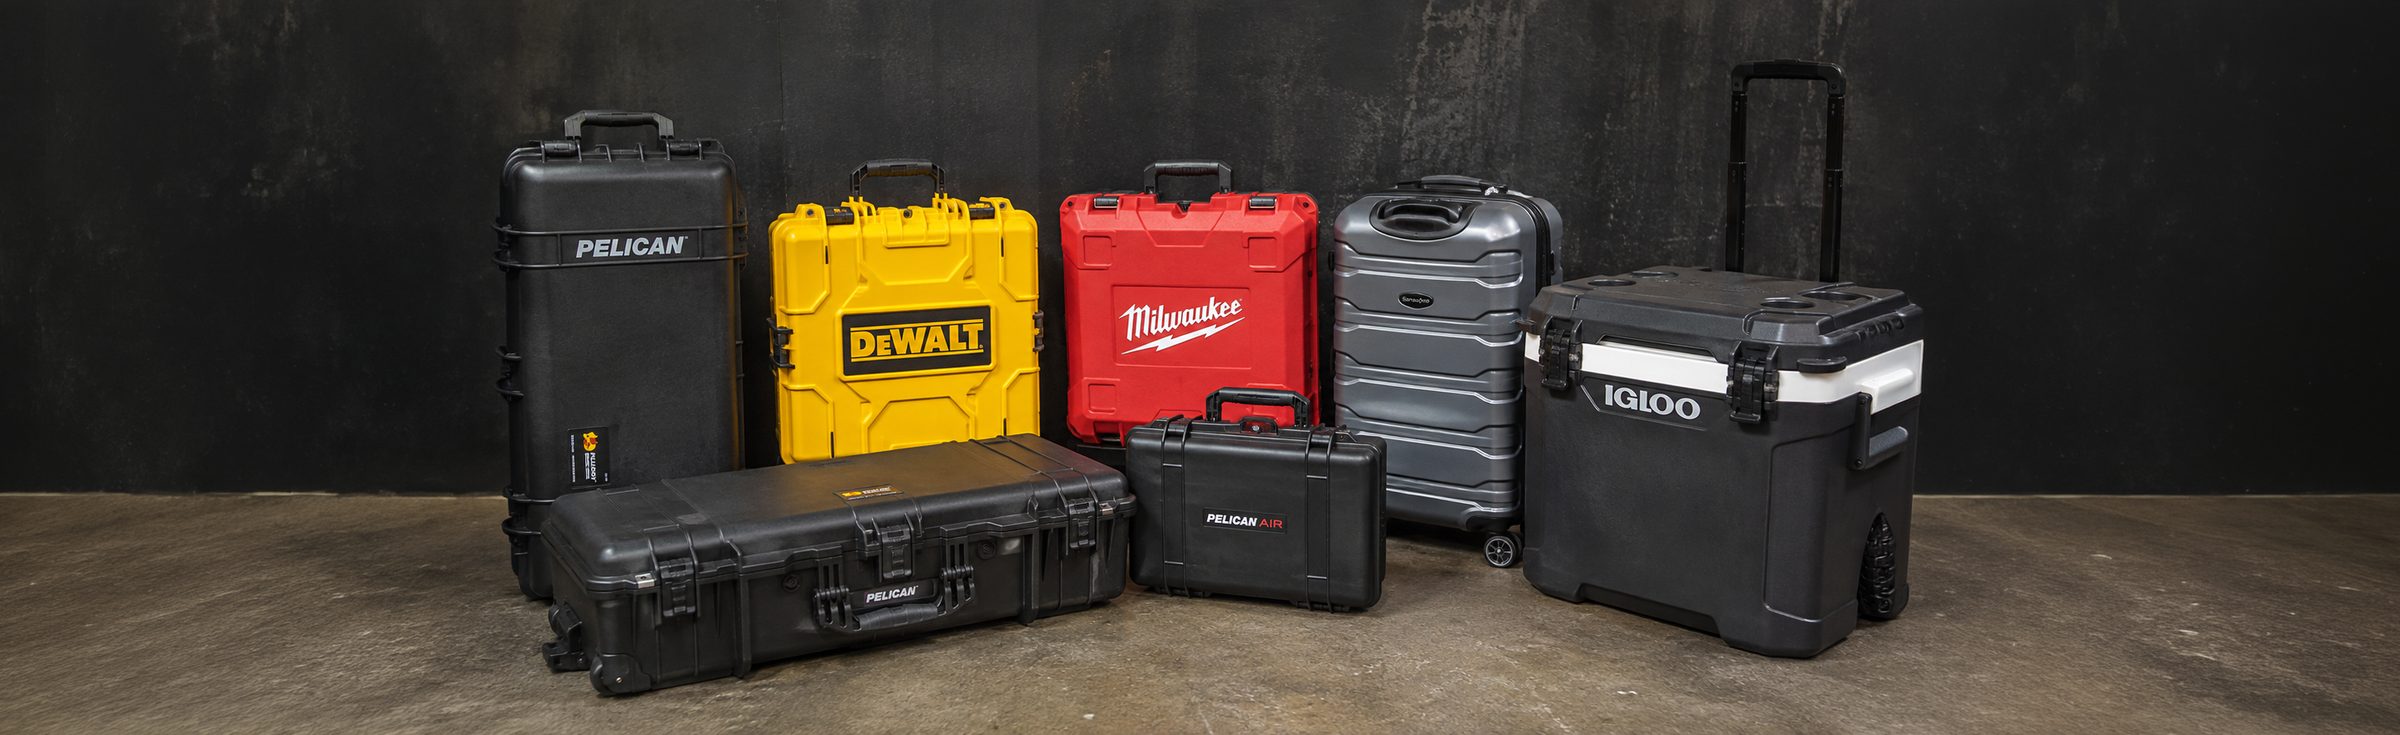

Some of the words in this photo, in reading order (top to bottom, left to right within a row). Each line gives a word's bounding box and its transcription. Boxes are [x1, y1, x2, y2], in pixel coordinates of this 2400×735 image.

[576, 236, 684, 258] PELICAN
[1119, 296, 1242, 341] Milwaukee
[1605, 384, 1700, 420] IGLOO
[1206, 513, 1257, 527] PELICAN
[1258, 518, 1283, 529] AIR
[866, 585, 916, 603] PELICAN
